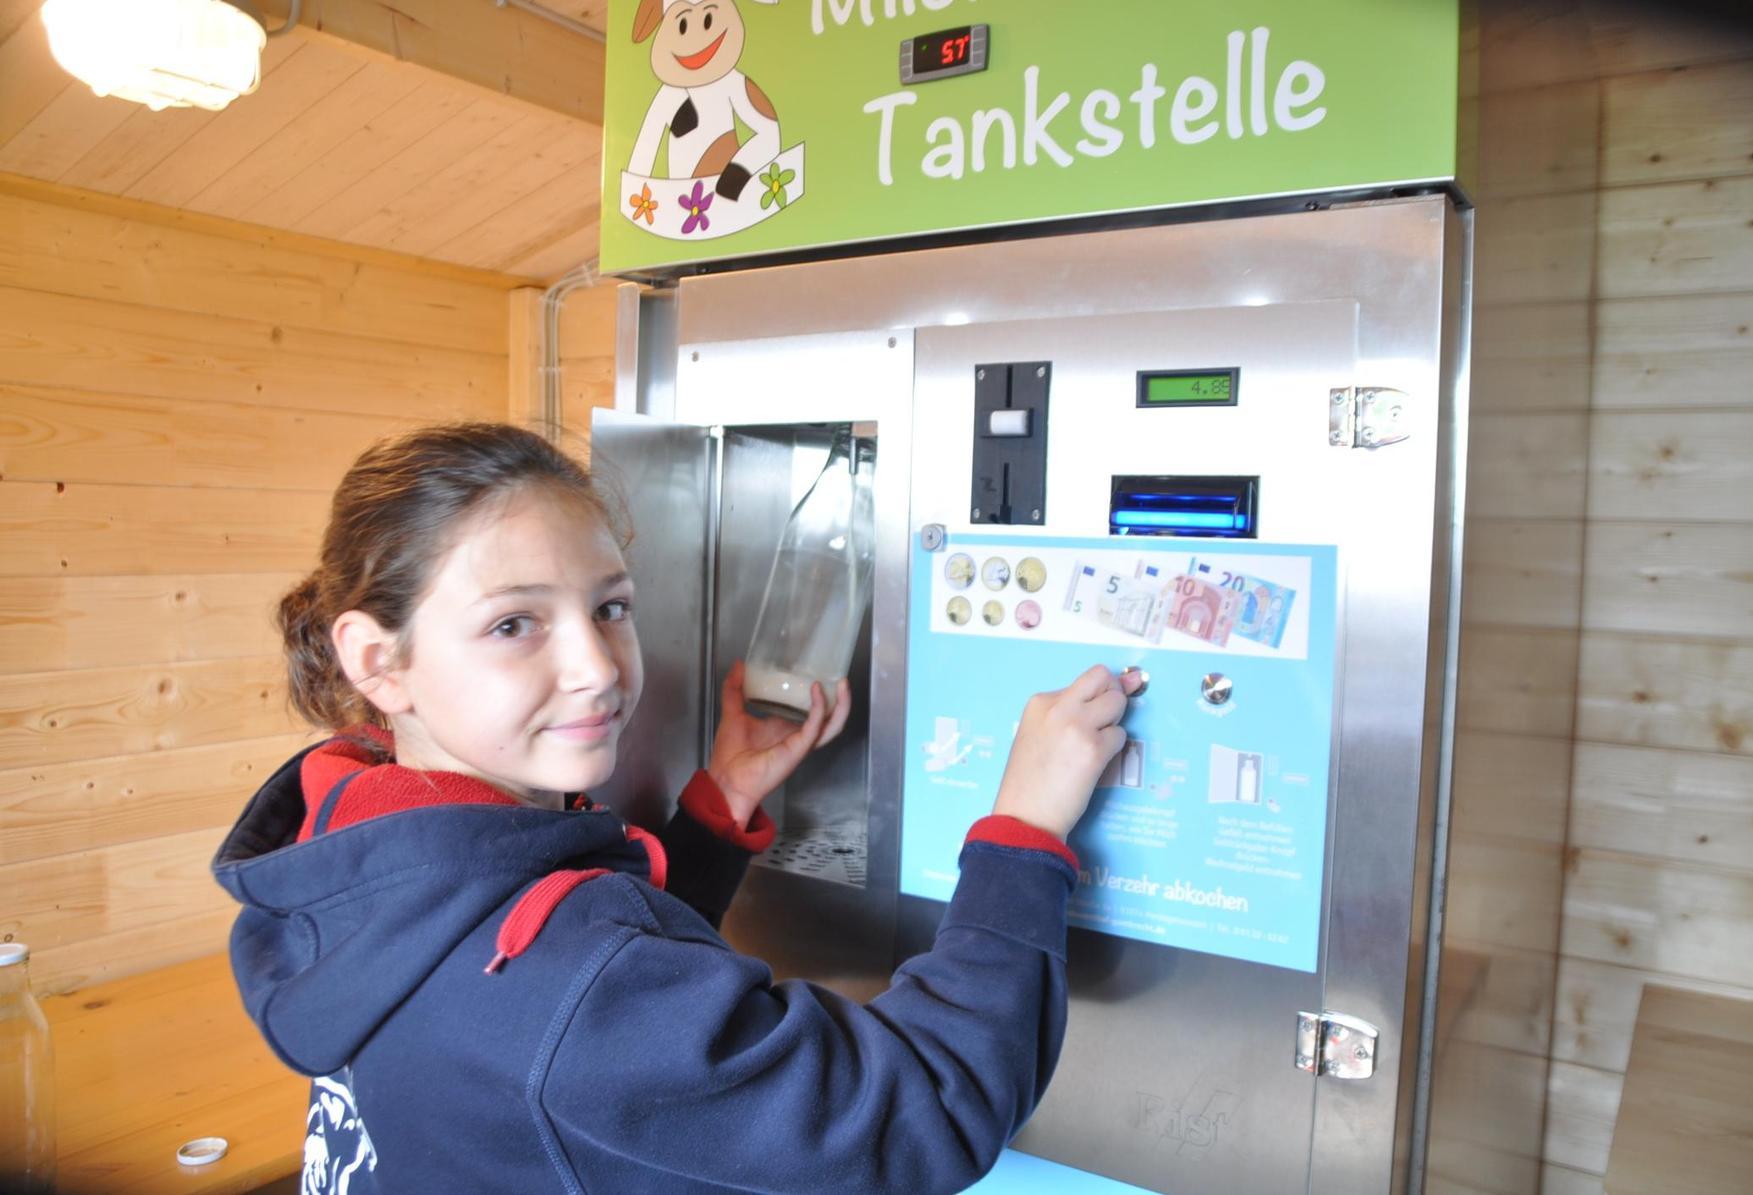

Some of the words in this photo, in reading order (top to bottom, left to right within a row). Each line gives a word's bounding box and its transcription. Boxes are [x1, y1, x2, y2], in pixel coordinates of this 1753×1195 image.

[863, 27, 1327, 185] Tankstelle
[1106, 576, 1121, 594] 5
[1174, 576, 1196, 596] 10
[1219, 571, 1245, 592] 20
[1095, 867, 1160, 898] Verzehr
[1164, 879, 1249, 912] abkochen
